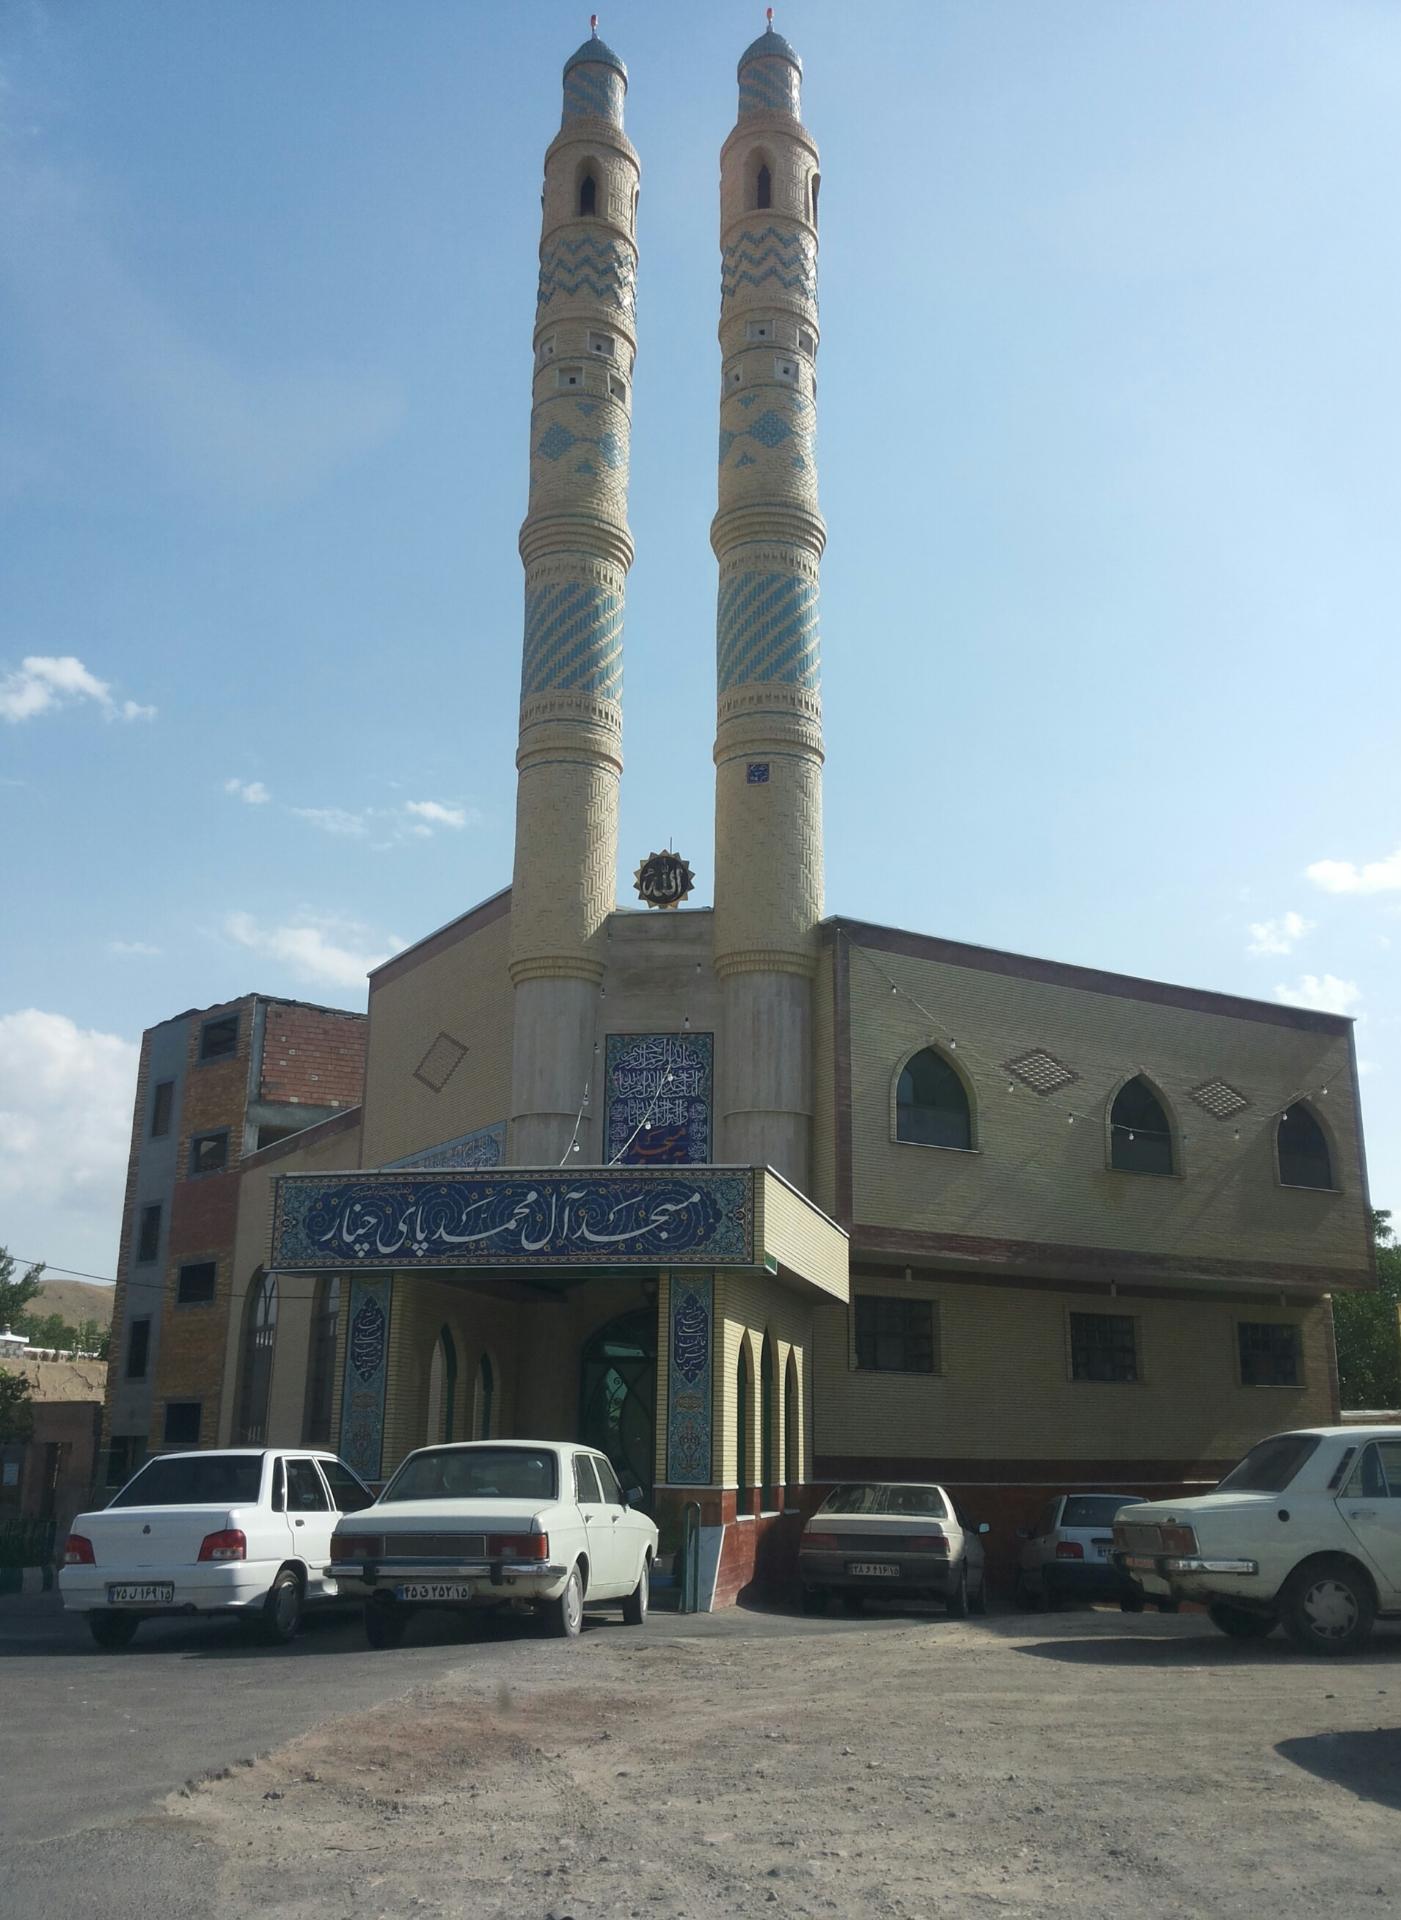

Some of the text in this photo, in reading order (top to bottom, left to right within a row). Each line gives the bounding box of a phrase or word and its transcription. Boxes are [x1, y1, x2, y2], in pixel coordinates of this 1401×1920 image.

[642, 857, 683, 897] الله
[319, 1189, 701, 1258] مسجد آل محمد پای چنار
[456, 1587, 467, 1598] ۱۵
